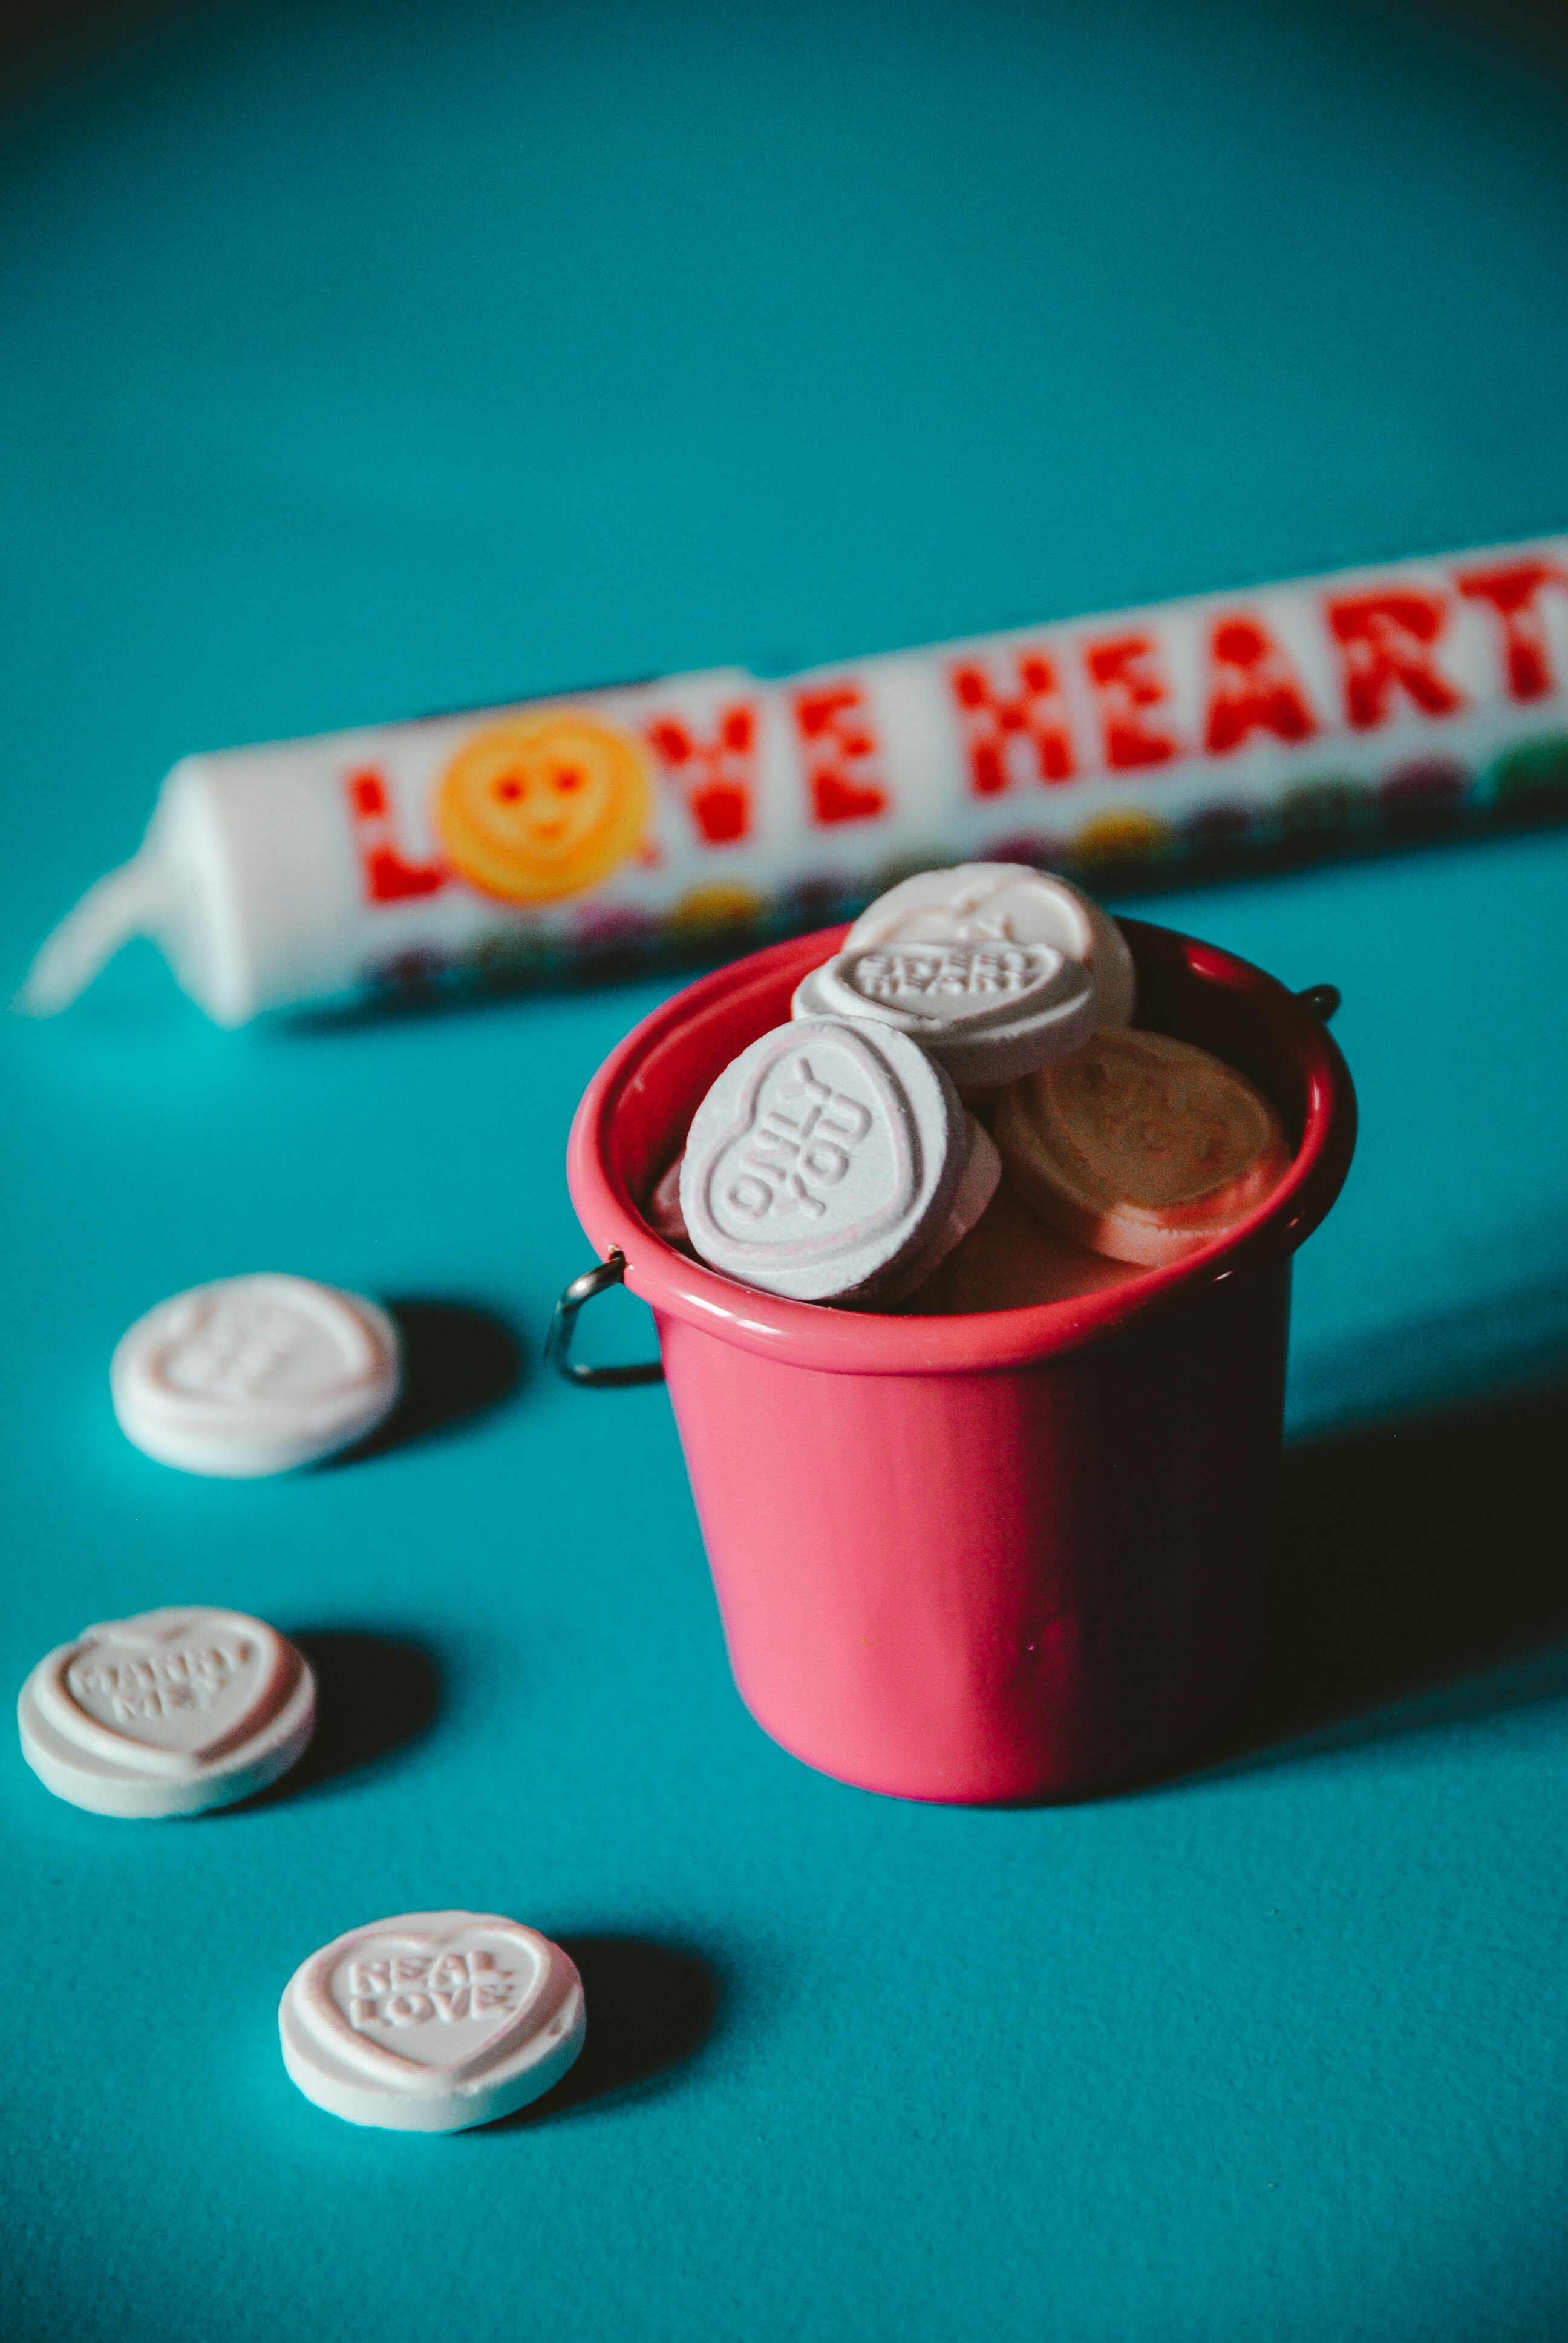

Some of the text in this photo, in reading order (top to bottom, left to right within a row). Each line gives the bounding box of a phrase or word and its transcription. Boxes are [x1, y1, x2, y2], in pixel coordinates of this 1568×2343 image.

[861, 971, 1025, 996] HEART
[725, 1056, 833, 1223] ONLY
[769, 1092, 874, 1221] YOU
[348, 1950, 513, 1997] REAL
[348, 1983, 517, 2030] LOVE
